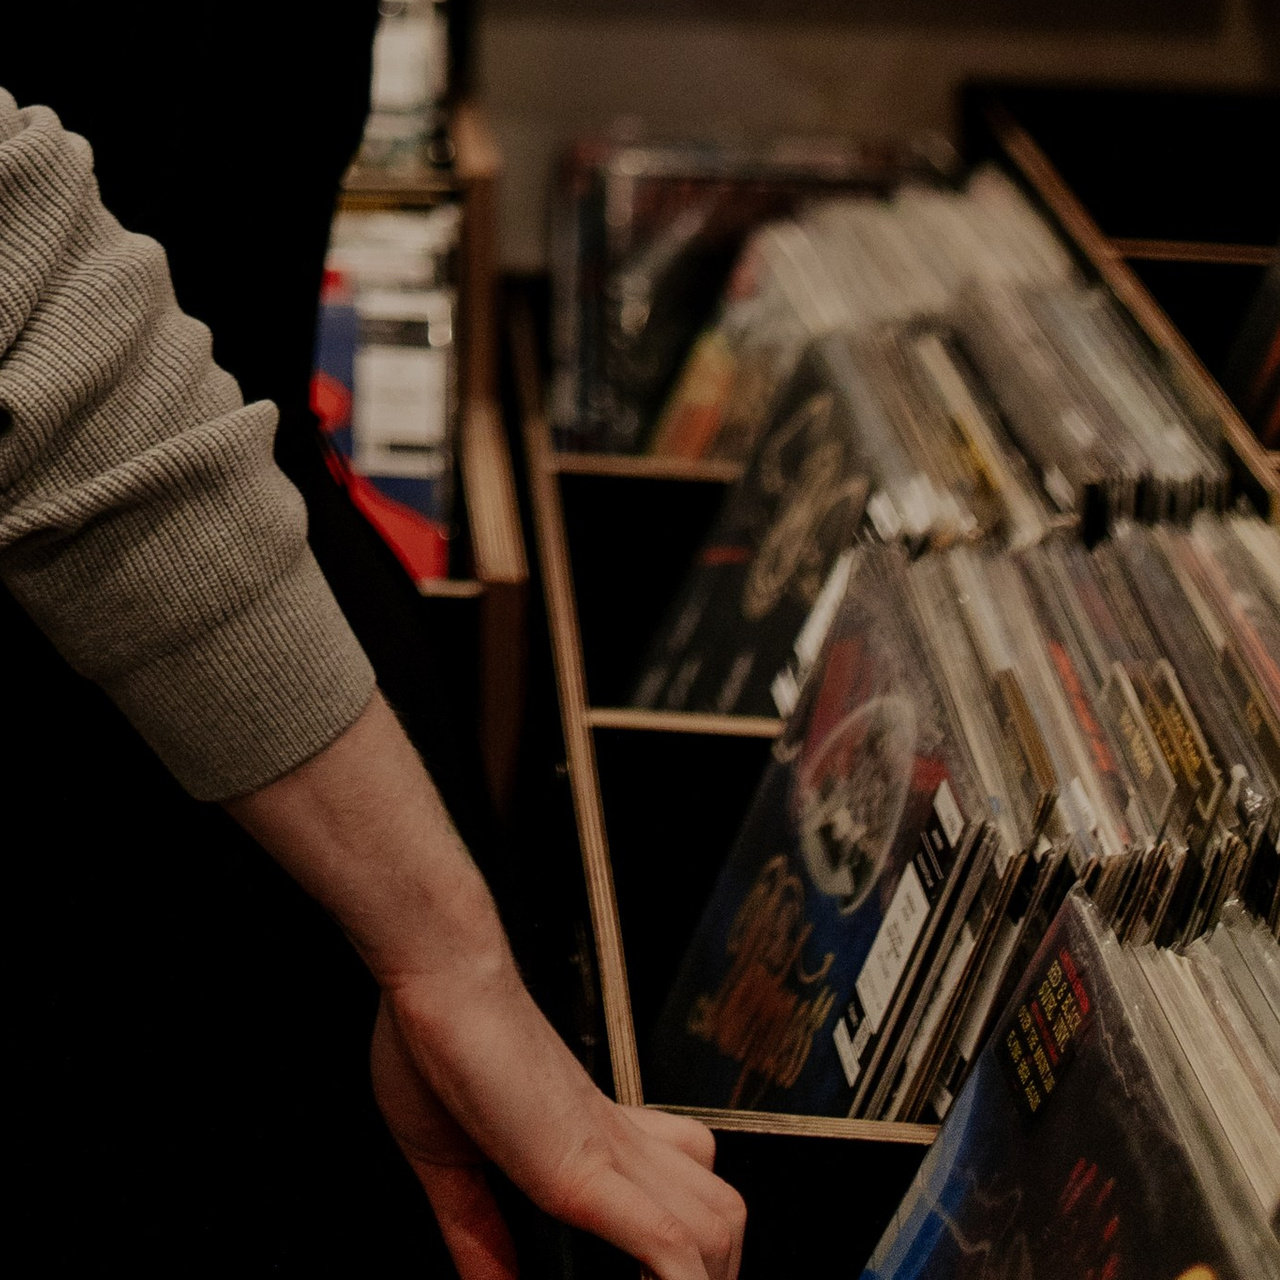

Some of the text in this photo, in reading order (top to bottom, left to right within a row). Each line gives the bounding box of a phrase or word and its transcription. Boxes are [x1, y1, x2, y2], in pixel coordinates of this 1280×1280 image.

[1038, 980, 1057, 1021] SWIRL
[1052, 1013, 1070, 1053] VINYL
[1047, 959, 1081, 1036] RED & BLACK
